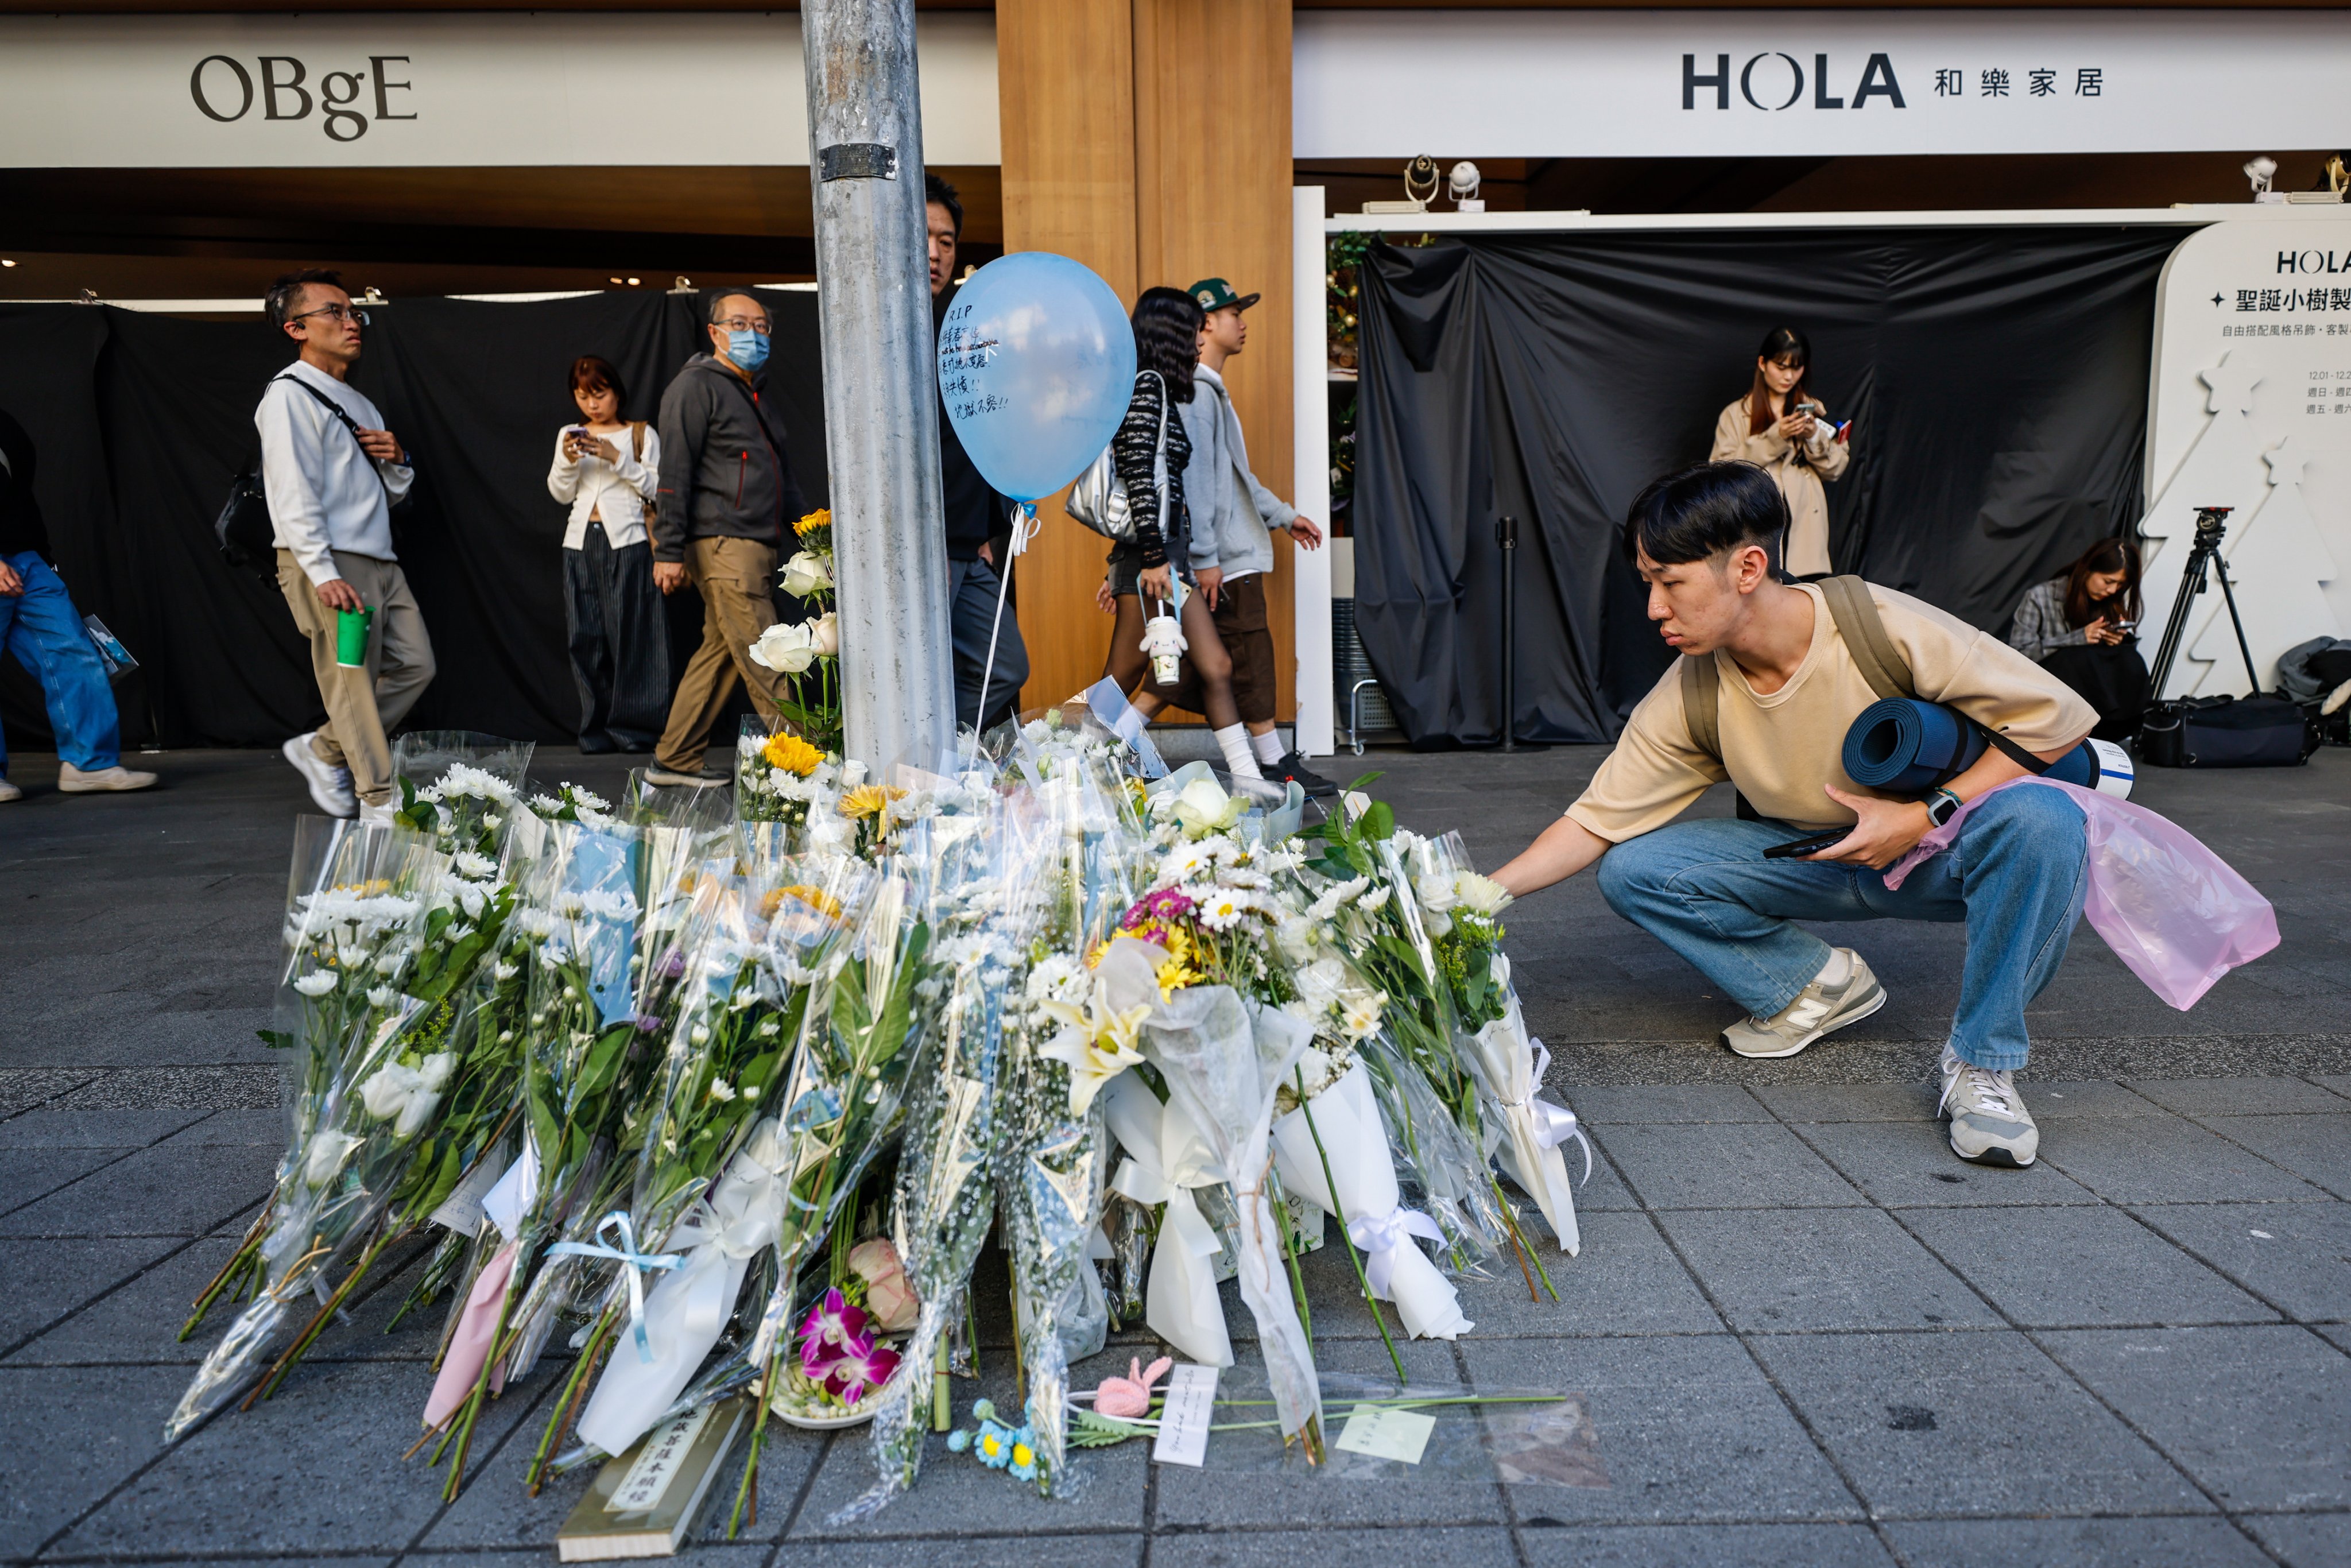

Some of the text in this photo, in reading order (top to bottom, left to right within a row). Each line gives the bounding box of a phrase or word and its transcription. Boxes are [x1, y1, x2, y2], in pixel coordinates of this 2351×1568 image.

[191, 55, 417, 142] OBgE
[1683, 52, 2103, 110] HOLA 和樂家居
[2236, 288, 2351, 312] 聖誕小樹製
[2310, 371, 2329, 380] 12.01
